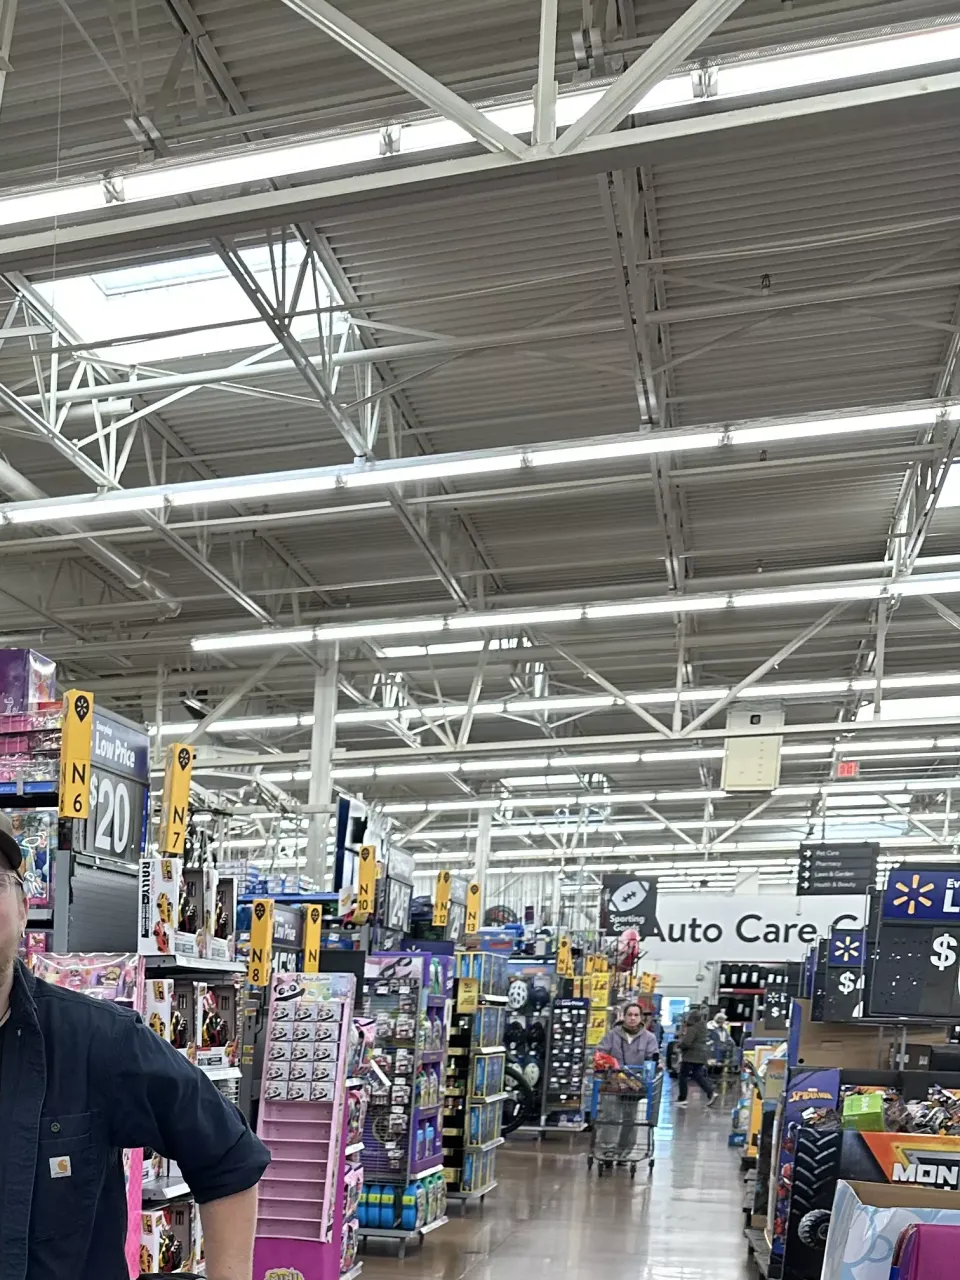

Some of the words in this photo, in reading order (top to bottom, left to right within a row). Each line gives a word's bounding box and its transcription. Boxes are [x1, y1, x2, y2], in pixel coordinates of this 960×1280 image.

[96, 732, 114, 759] Low
[114, 740, 136, 767] Price
[72, 763, 86, 785] N
[73, 793, 82, 812] 6
[173, 806, 184, 826] N
[173, 832, 180, 849] 7
[141, 862, 151, 895] RALLY
[360, 884, 368, 895] N
[359, 899, 368, 910] 10
[469, 911, 476, 920] N
[609, 914, 645, 926] Sporting
[642, 916, 722, 944] Auto
[735, 914, 818, 944] Care
[252, 949, 262, 963] N
[309, 950, 317, 962] N
[252, 969, 259, 982] 8
